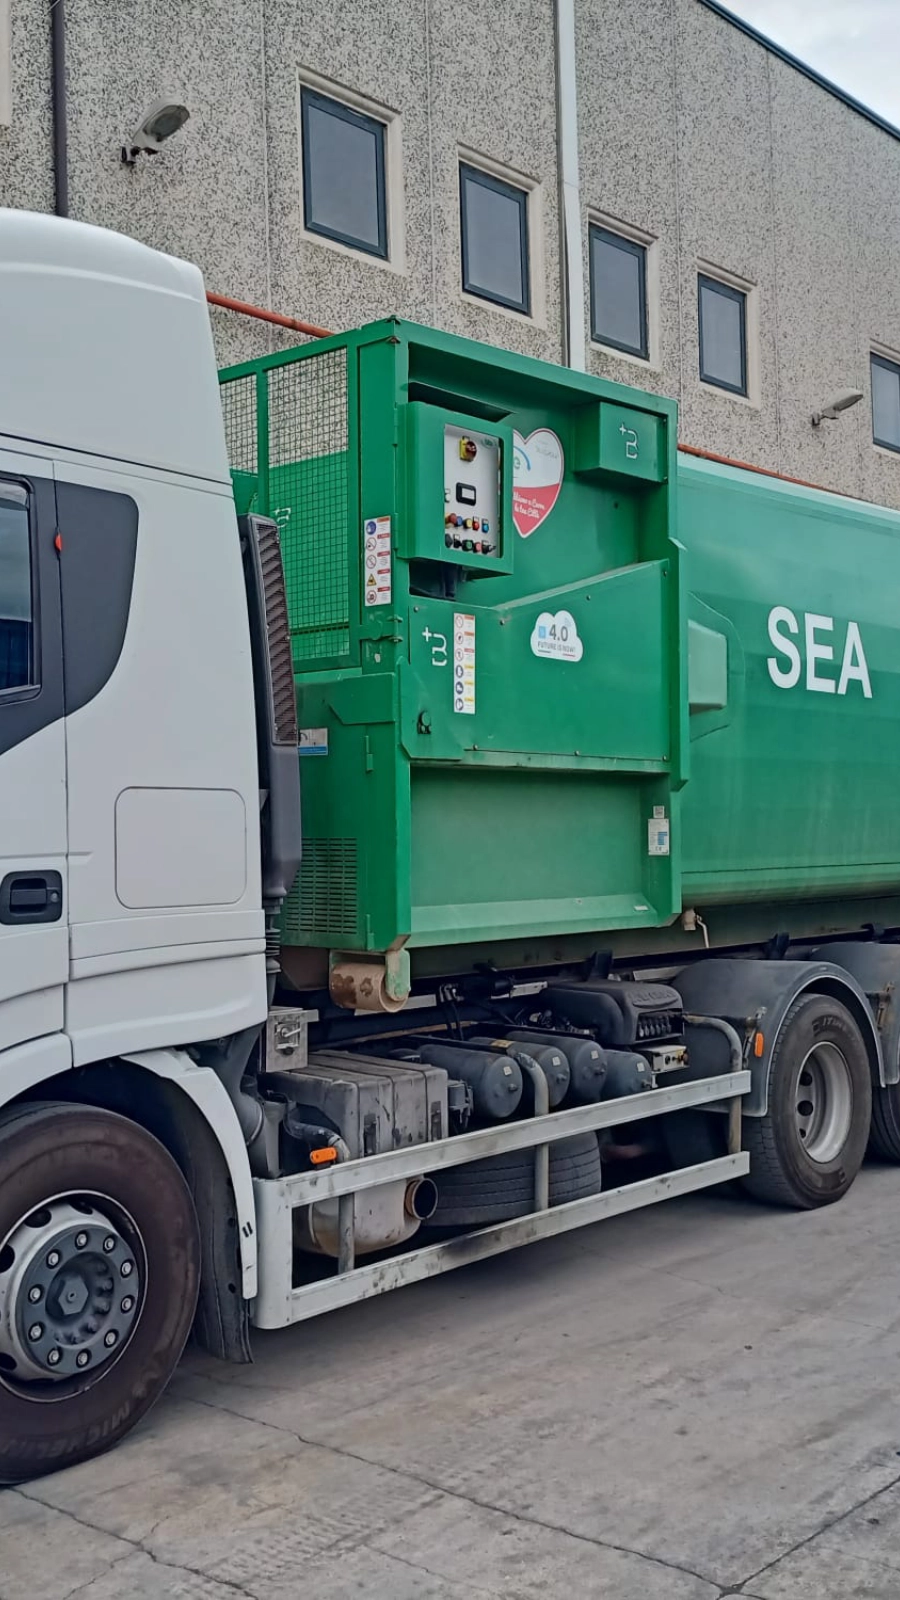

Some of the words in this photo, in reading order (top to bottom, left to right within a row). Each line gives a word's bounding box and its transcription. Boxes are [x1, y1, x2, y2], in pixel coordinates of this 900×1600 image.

[549, 624, 569, 642] 4.0
[537, 641, 557, 651] FUTURE
[767, 606, 872, 698] SEA
